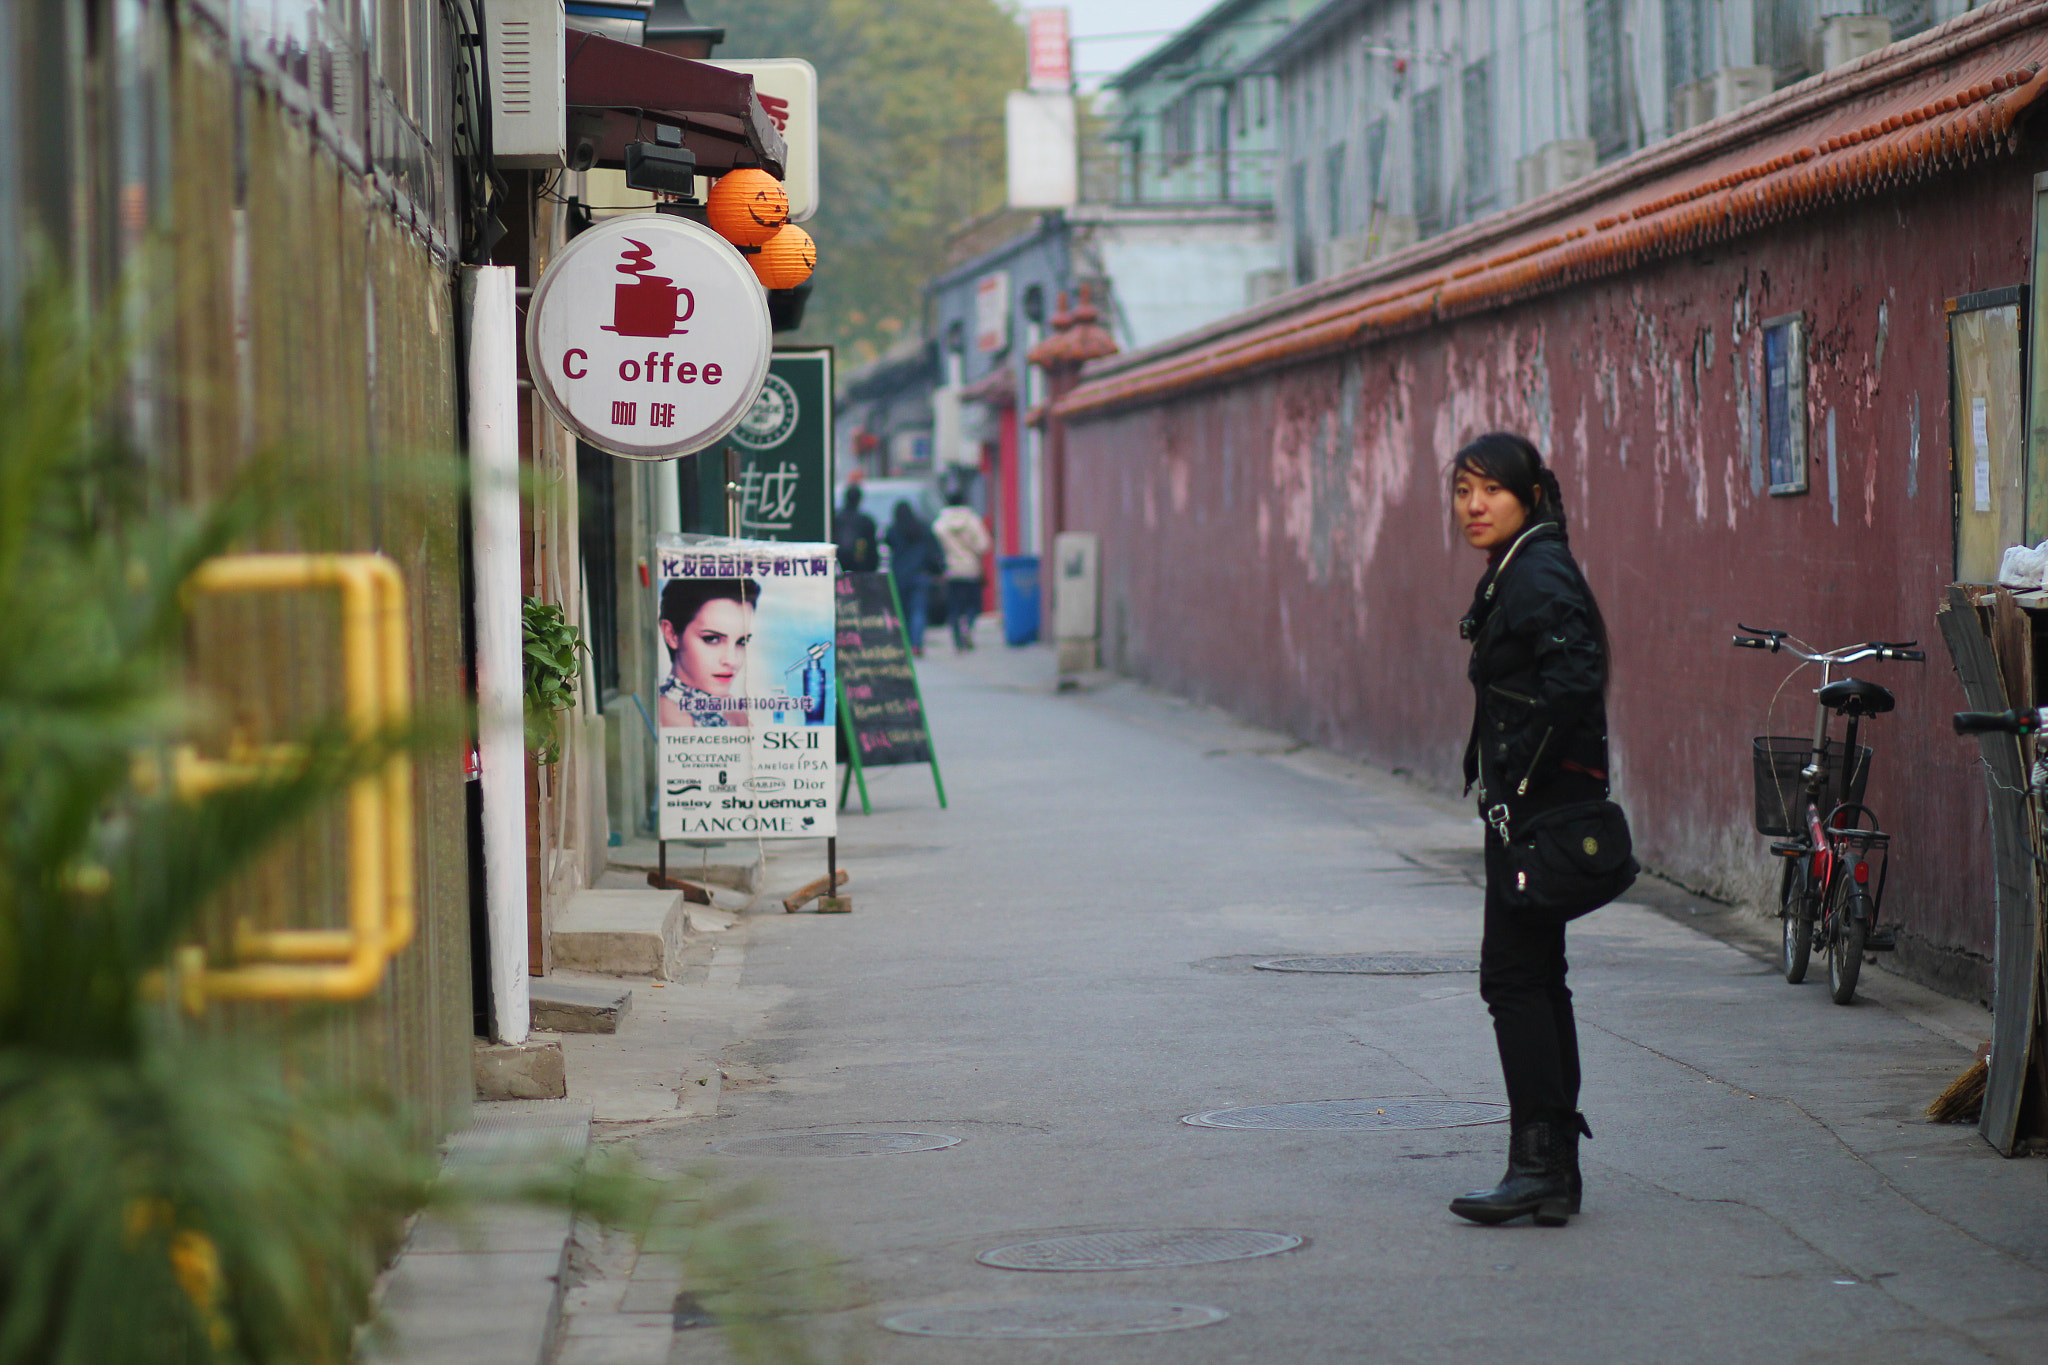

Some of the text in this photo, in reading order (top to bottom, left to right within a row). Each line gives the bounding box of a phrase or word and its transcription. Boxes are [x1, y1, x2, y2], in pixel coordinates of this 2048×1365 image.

[611, 401, 676, 428] 咖啡
[762, 731, 820, 750] SK-II
[793, 779, 826, 790] Dior
[667, 799, 712, 808] sisley
[721, 796, 827, 809] shu uemura
